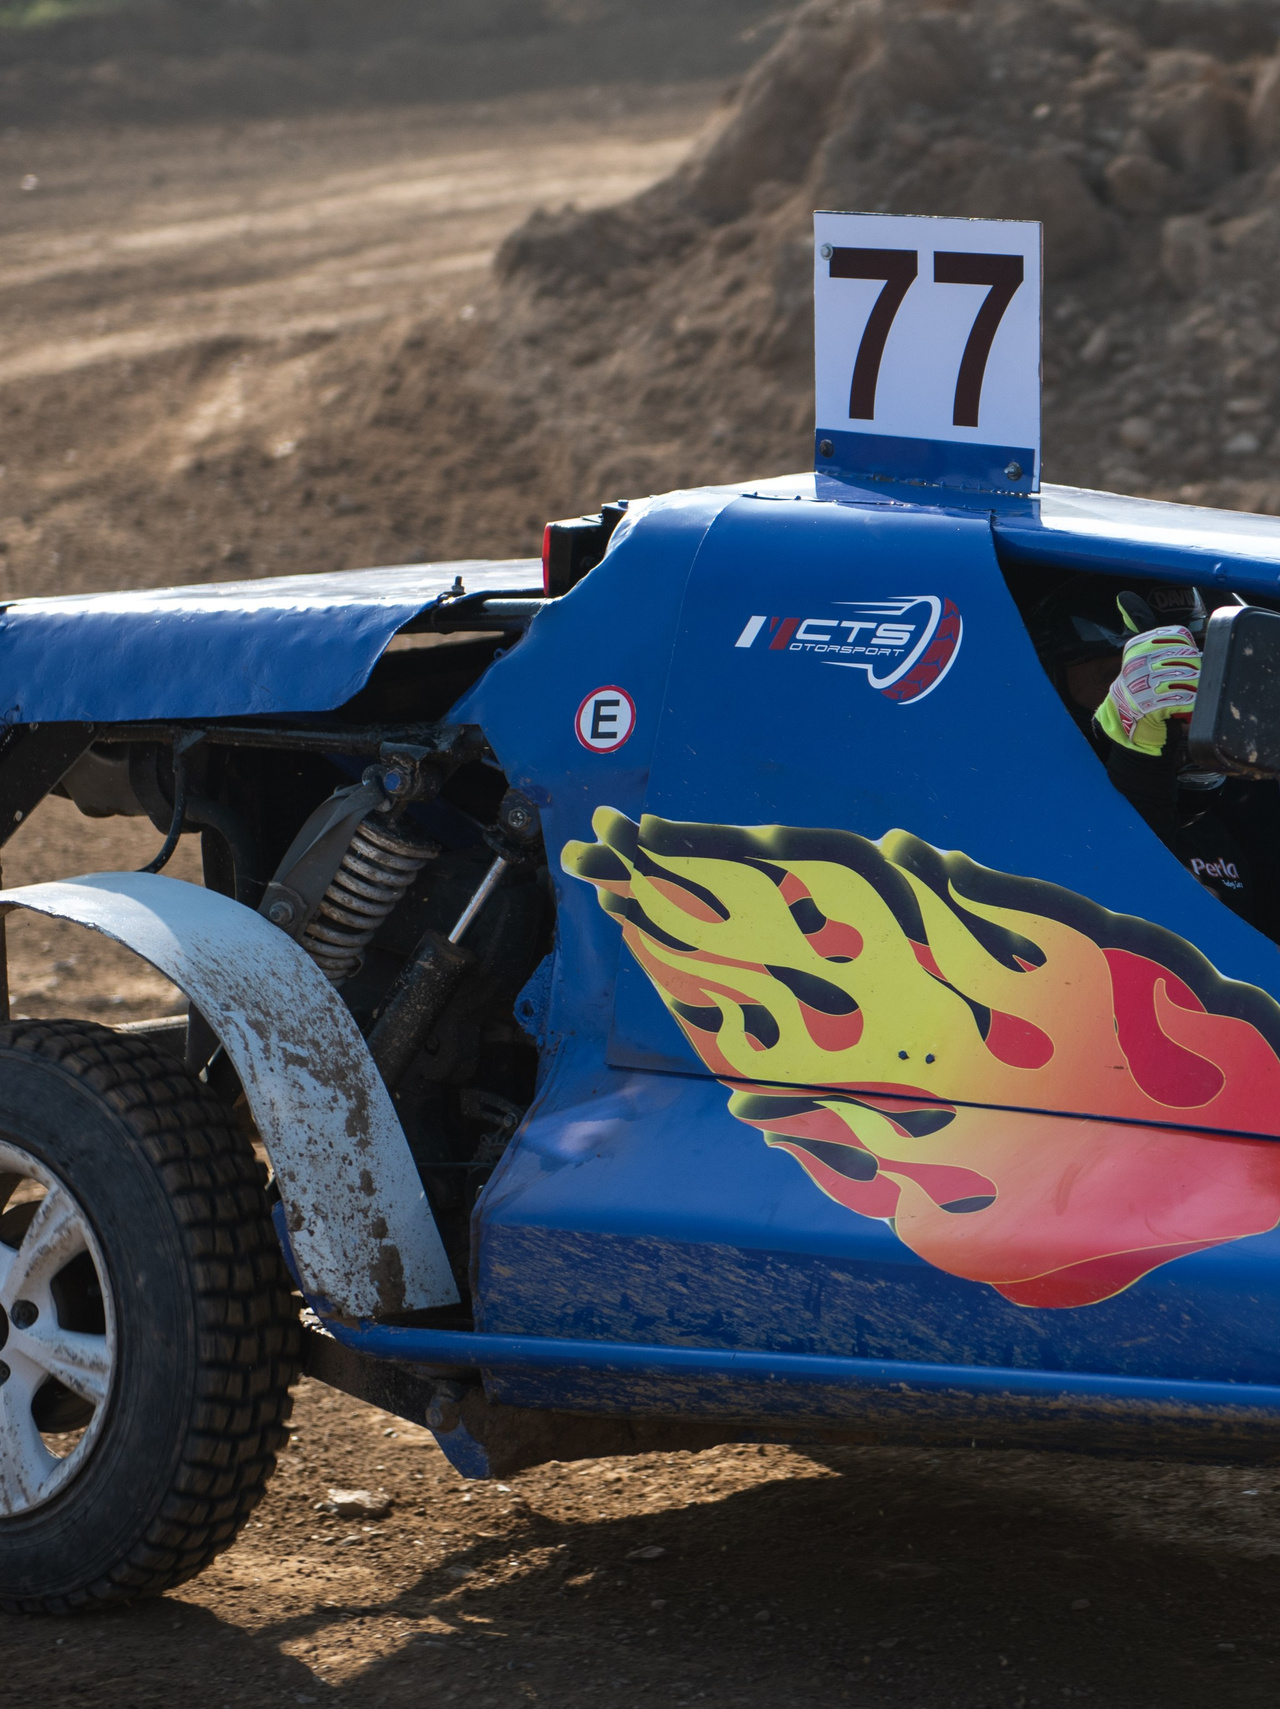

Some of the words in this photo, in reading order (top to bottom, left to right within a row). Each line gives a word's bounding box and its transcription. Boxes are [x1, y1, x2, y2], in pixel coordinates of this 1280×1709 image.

[829, 246, 1024, 428] 77
[796, 618, 916, 645] CTS
[591, 699, 620, 739] E
[1191, 857, 1240, 878] Perla
